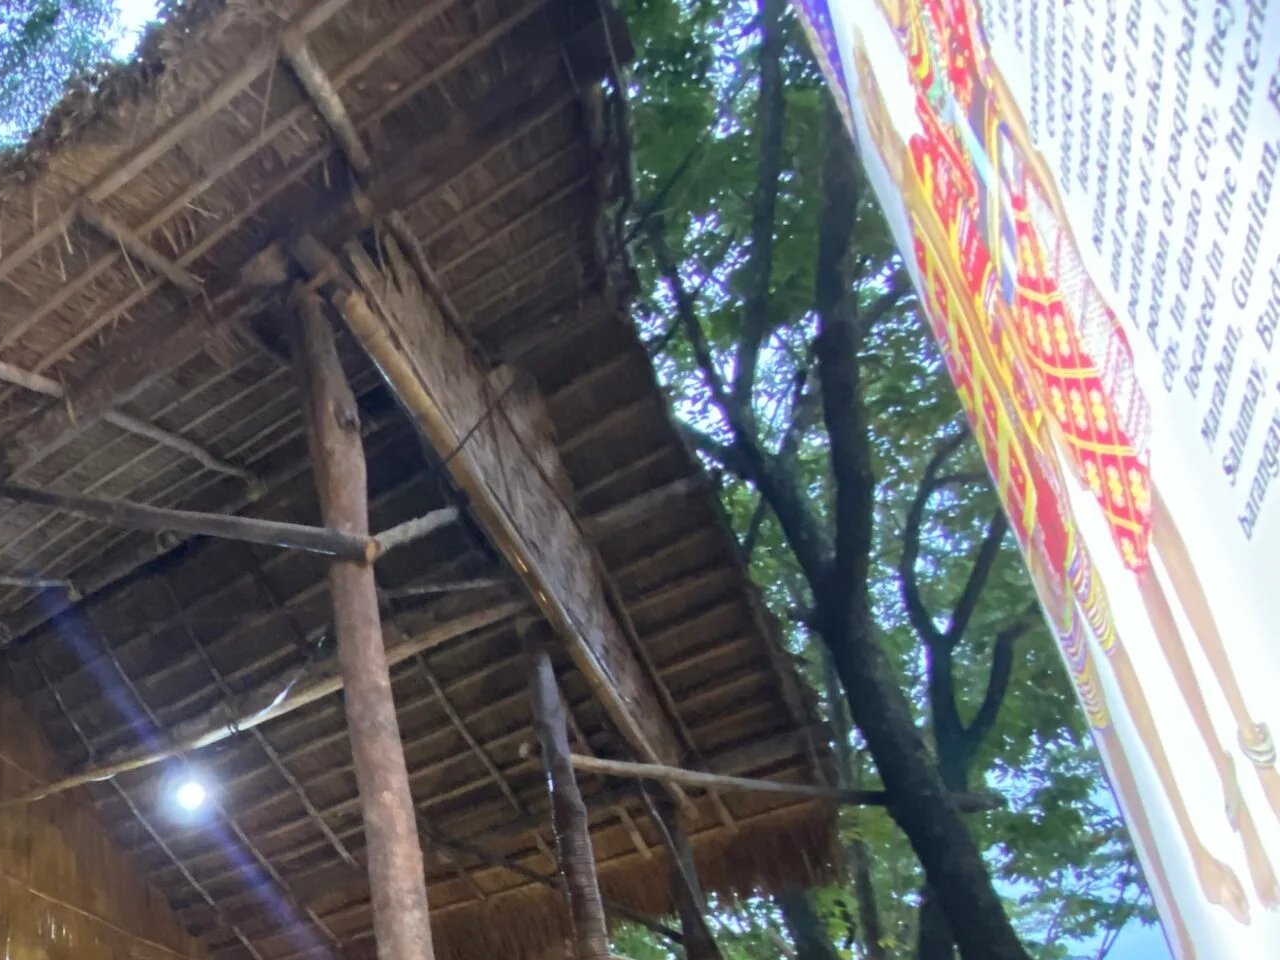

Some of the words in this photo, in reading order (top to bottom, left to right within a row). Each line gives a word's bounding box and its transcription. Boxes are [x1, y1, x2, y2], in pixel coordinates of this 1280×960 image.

[1123, 45, 1138, 99] of
[1141, 22, 1167, 168] Arakan
[1115, 105, 1135, 240] portion
[1139, 155, 1153, 206] of
[1213, 165, 1238, 236] the
[1109, 228, 1124, 294] and
[1127, 209, 1148, 331] portion
[1146, 229, 1171, 353] portion
[1161, 175, 1175, 228] of
[1176, 188, 1202, 292] davao
[1205, 238, 1224, 283] in
[1183, 275, 1217, 400] located
[1200, 323, 1244, 454] Marahan,
[1222, 356, 1269, 489] Salumay,
